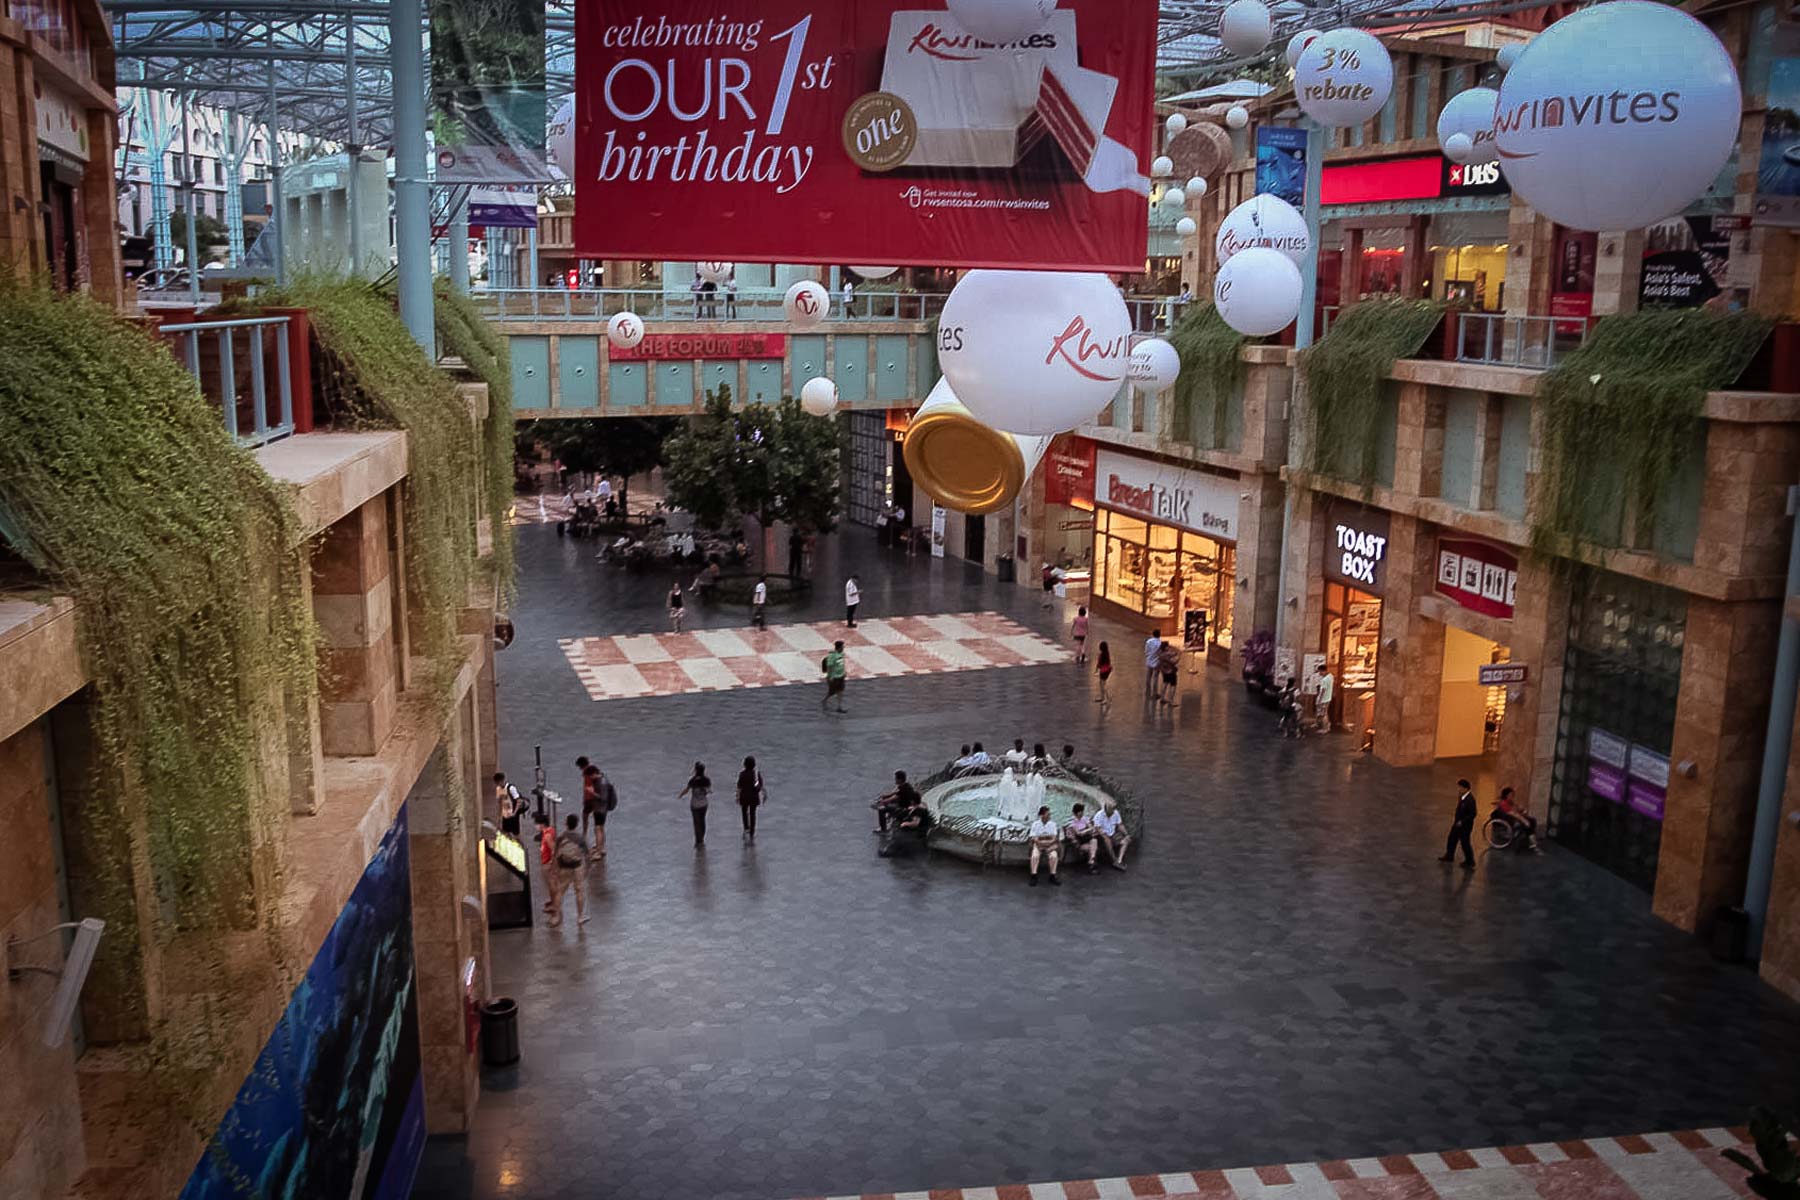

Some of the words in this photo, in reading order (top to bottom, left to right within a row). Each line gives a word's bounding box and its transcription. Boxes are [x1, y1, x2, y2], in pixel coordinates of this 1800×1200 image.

[603, 14, 764, 51] celebrating
[1316, 47, 1361, 72] 3%
[604, 57, 757, 122] OUR
[1304, 77, 1374, 100] rebate
[856, 108, 905, 154] one
[597, 128, 814, 194] birthday
[1462, 161, 1500, 186] DBS
[667, 338, 732, 356] FORUM
[1336, 524, 1386, 560] TOAST
[1341, 552, 1375, 585] BOX
